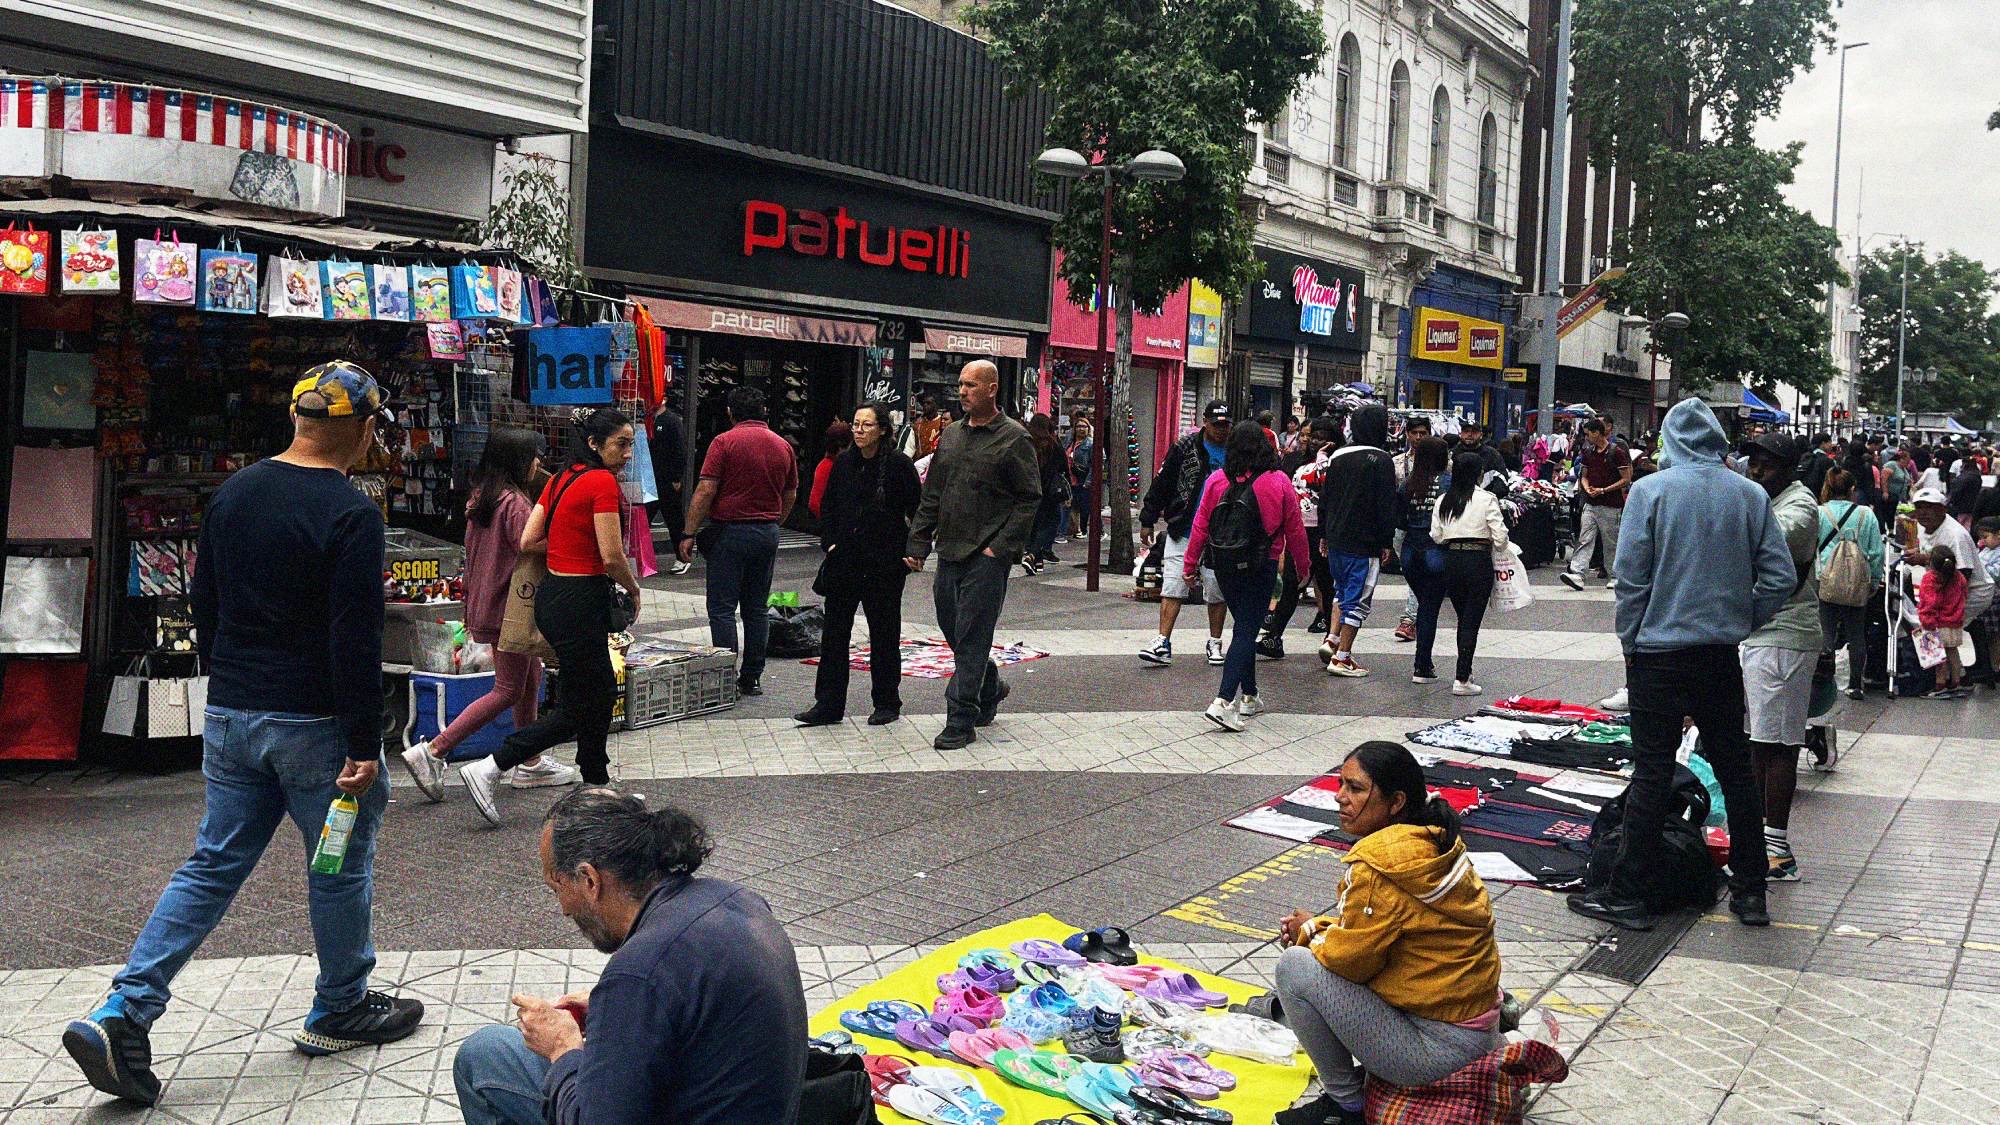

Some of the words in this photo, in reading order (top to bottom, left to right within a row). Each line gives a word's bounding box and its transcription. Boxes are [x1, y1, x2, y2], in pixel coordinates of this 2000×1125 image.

[744, 199, 970, 278] patuelli
[1292, 264, 1341, 307] Miami
[709, 309, 790, 335] patuelli
[878, 319, 906, 341] 732
[1300, 304, 1335, 335] OUTLET
[946, 333, 1001, 352] patuelli
[1427, 326, 1457, 349] Liquimax
[1470, 334, 1497, 355] Liquimax
[392, 560, 439, 581] SCORE
